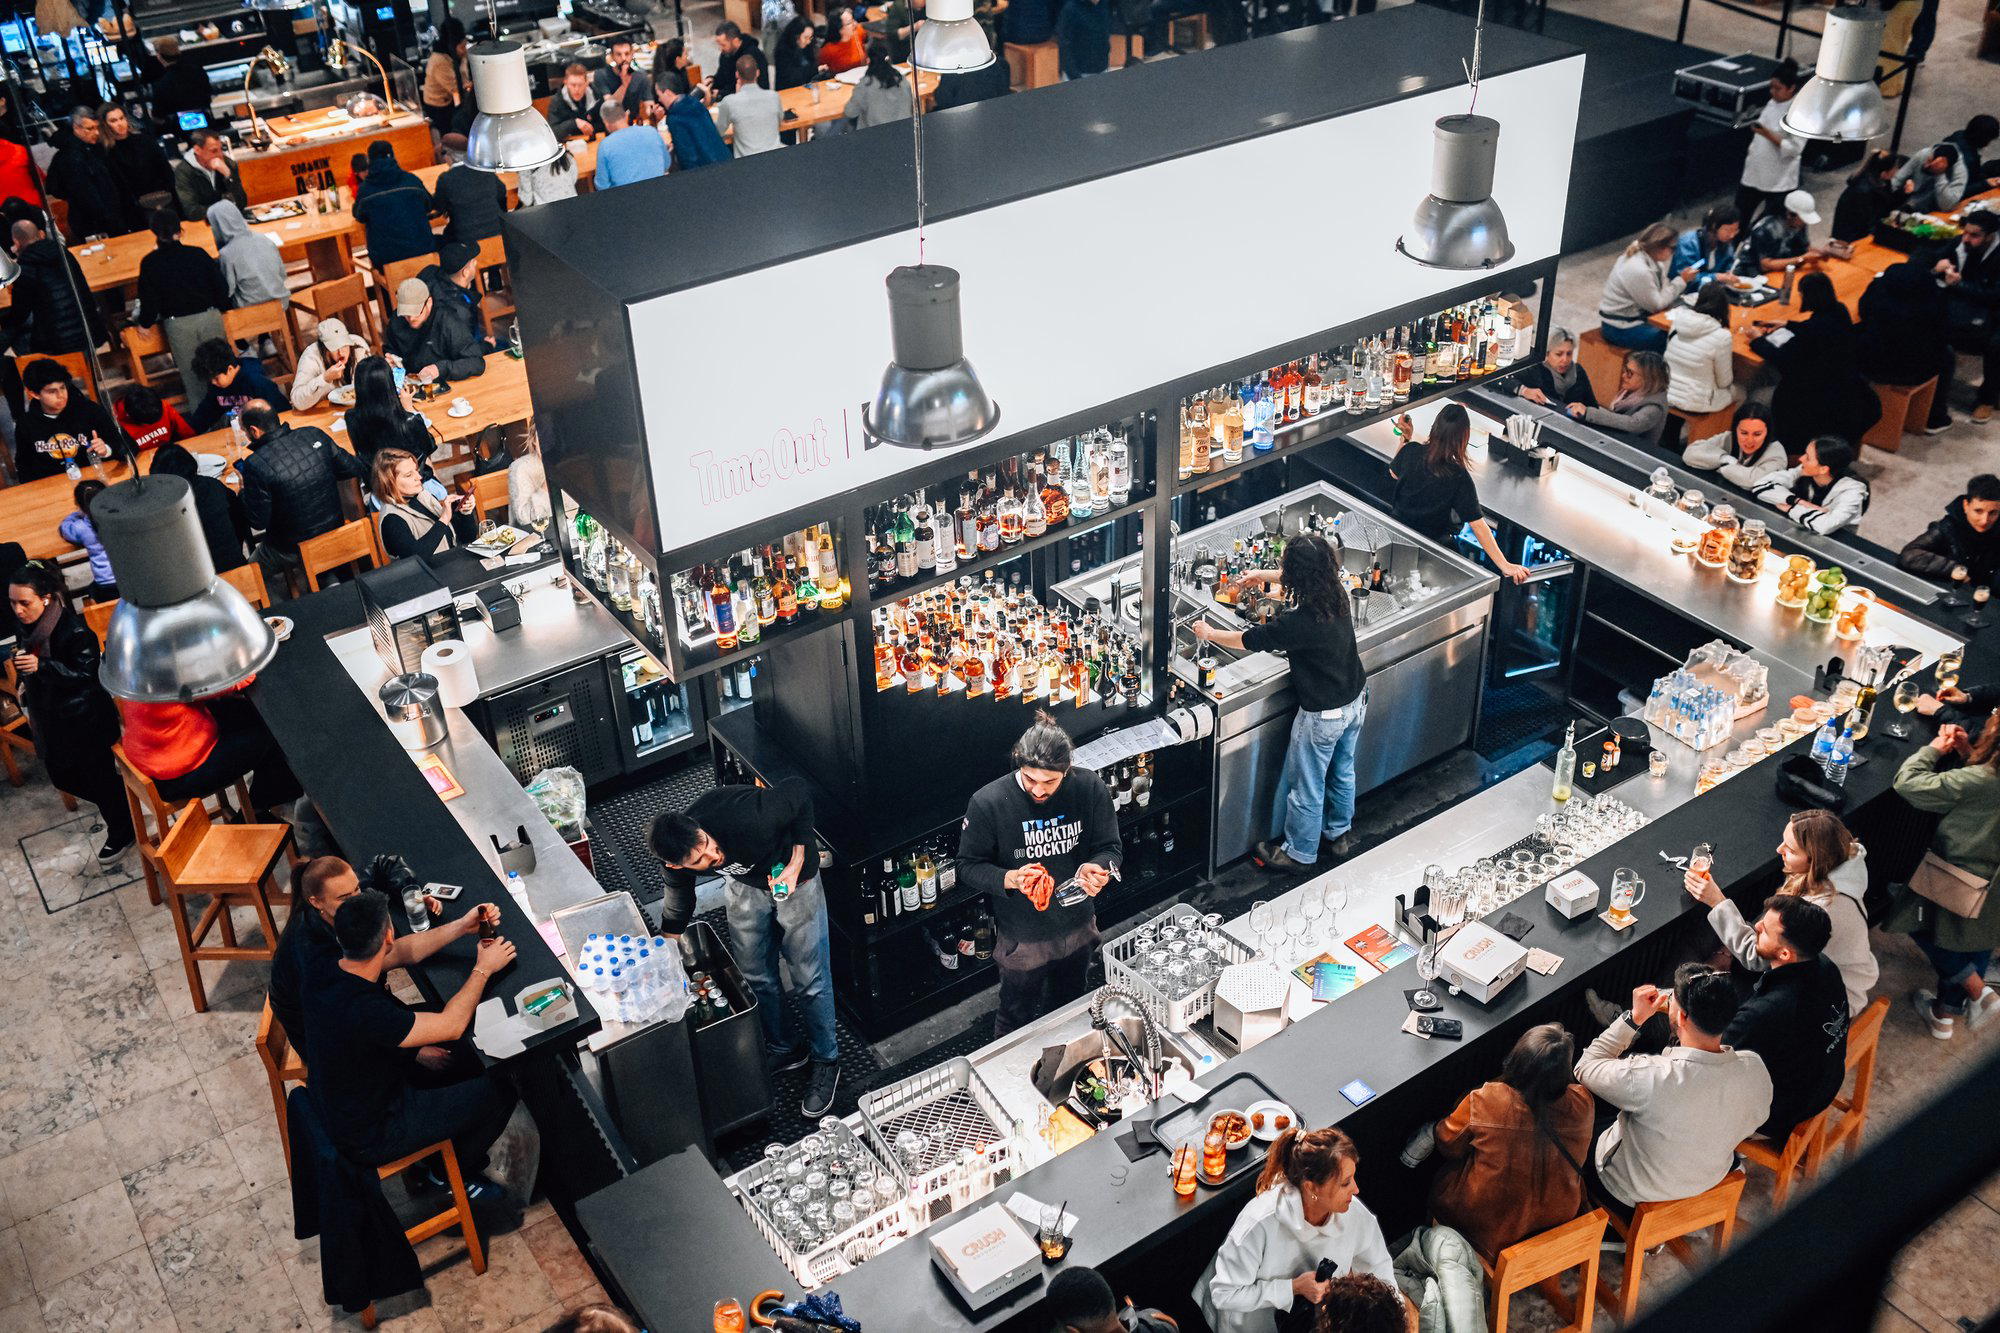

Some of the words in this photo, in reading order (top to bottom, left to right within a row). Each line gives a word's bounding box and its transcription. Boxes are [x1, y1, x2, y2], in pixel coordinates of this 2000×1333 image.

[135, 426, 169, 447] HARVARD
[1024, 820, 1084, 847] MOCKTAIL
[1025, 835, 1080, 860] COCKTAIL
[1462, 936, 1497, 961] CRUSH
[961, 1227, 1008, 1257] CRUSH
